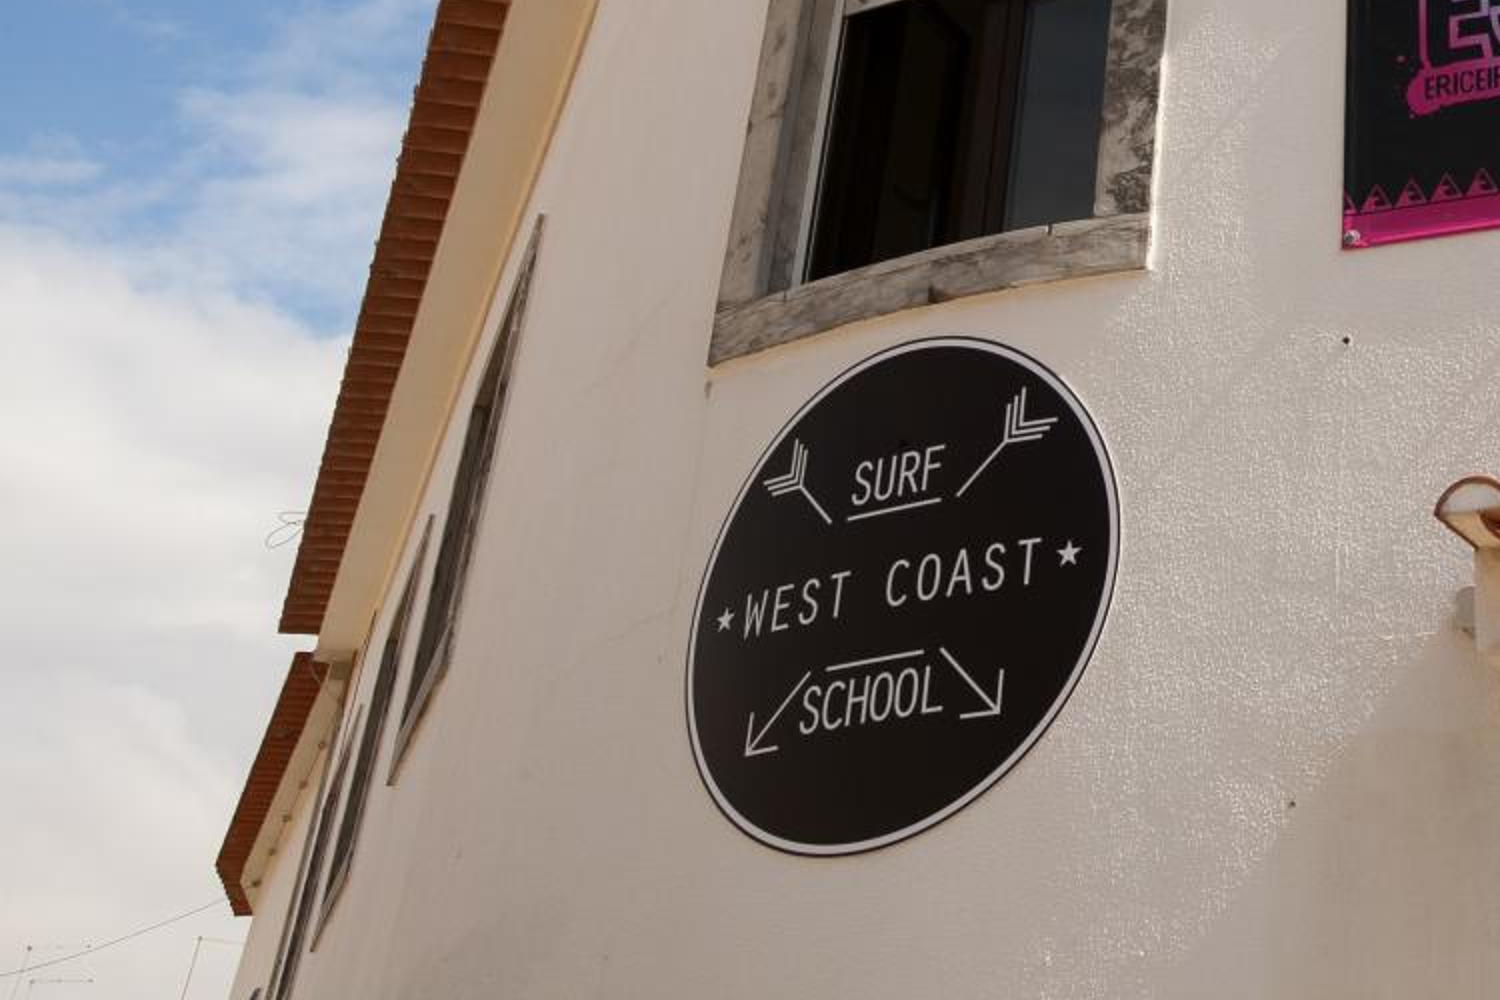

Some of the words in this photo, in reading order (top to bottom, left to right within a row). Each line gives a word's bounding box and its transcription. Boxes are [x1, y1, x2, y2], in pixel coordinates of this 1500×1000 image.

[852, 444, 946, 506] SURF
[744, 570, 852, 641] WEST
[886, 537, 1042, 608] COAST
[799, 665, 944, 735] SCHOOL
